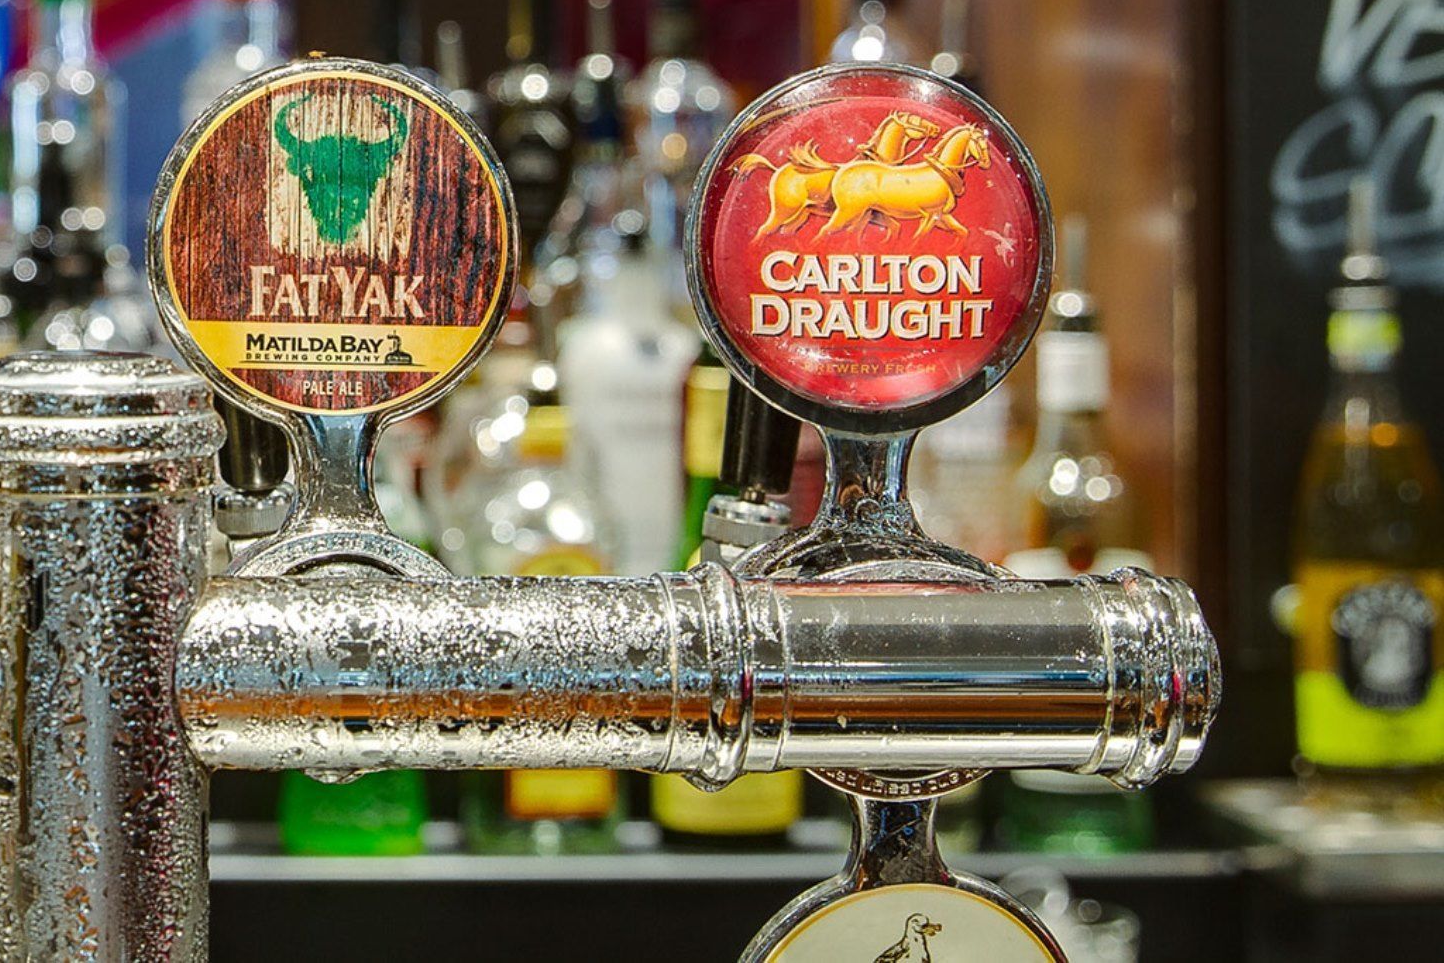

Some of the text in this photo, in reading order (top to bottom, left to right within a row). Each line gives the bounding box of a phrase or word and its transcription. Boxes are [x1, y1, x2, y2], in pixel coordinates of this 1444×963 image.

[760, 250, 983, 295] CARLTON
[749, 293, 994, 341] DRAUGHT
[245, 352, 380, 363] BREWING COMPANY
[805, 363, 878, 375] BREWERY
[302, 380, 364, 397] PALE ALE
